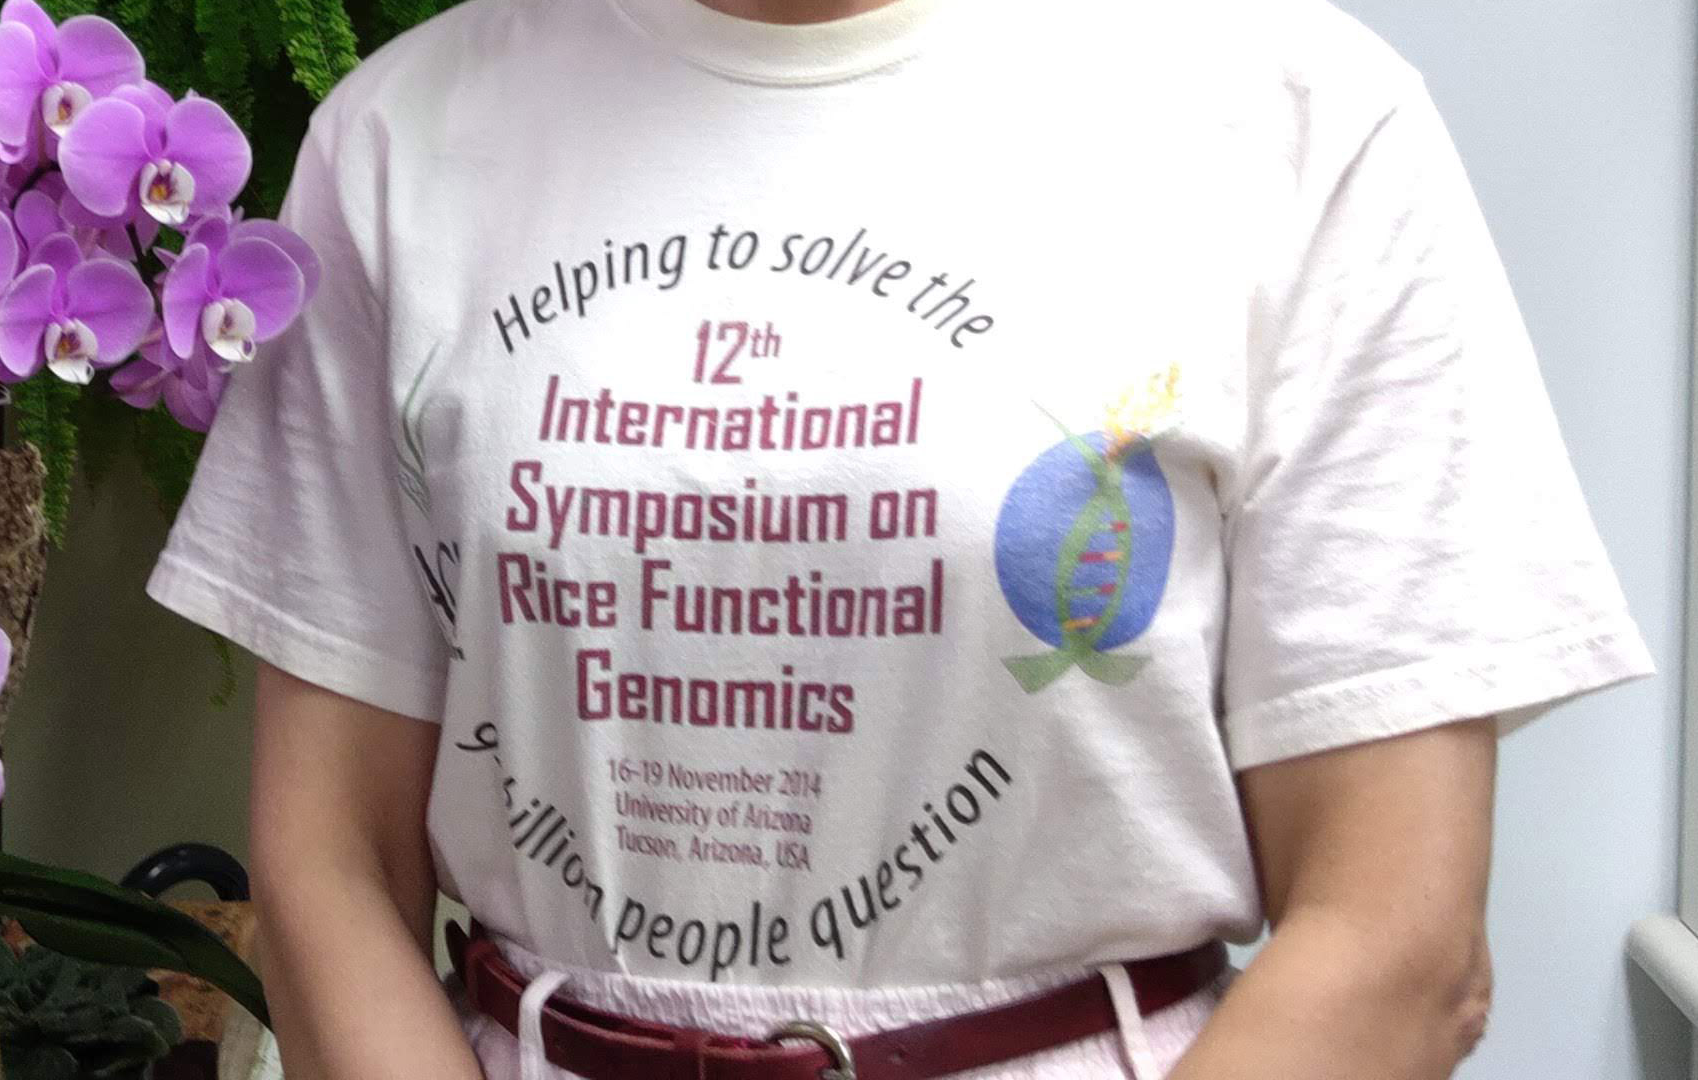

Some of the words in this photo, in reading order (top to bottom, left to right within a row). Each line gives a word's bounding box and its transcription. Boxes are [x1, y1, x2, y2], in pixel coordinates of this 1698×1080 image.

[492, 233, 687, 354] Helping
[707, 224, 759, 271] to
[771, 227, 913, 298] solve
[906, 271, 995, 349] the
[693, 320, 783, 384] 12th
[539, 374, 923, 452] International
[505, 460, 849, 554] Symposium
[869, 487, 939, 540] on
[497, 552, 618, 628] Rice
[640, 558, 945, 638] Functional
[576, 648, 855, 734] Genomics
[614, 790, 711, 833] University
[716, 800, 740, 827] of
[743, 803, 814, 836] Arizona
[668, 760, 774, 794] November
[777, 768, 823, 799] 2014
[614, 895, 792, 983] people
[810, 748, 1013, 960] question
[688, 834, 771, 870] Arizona,
[775, 838, 813, 872] USA
